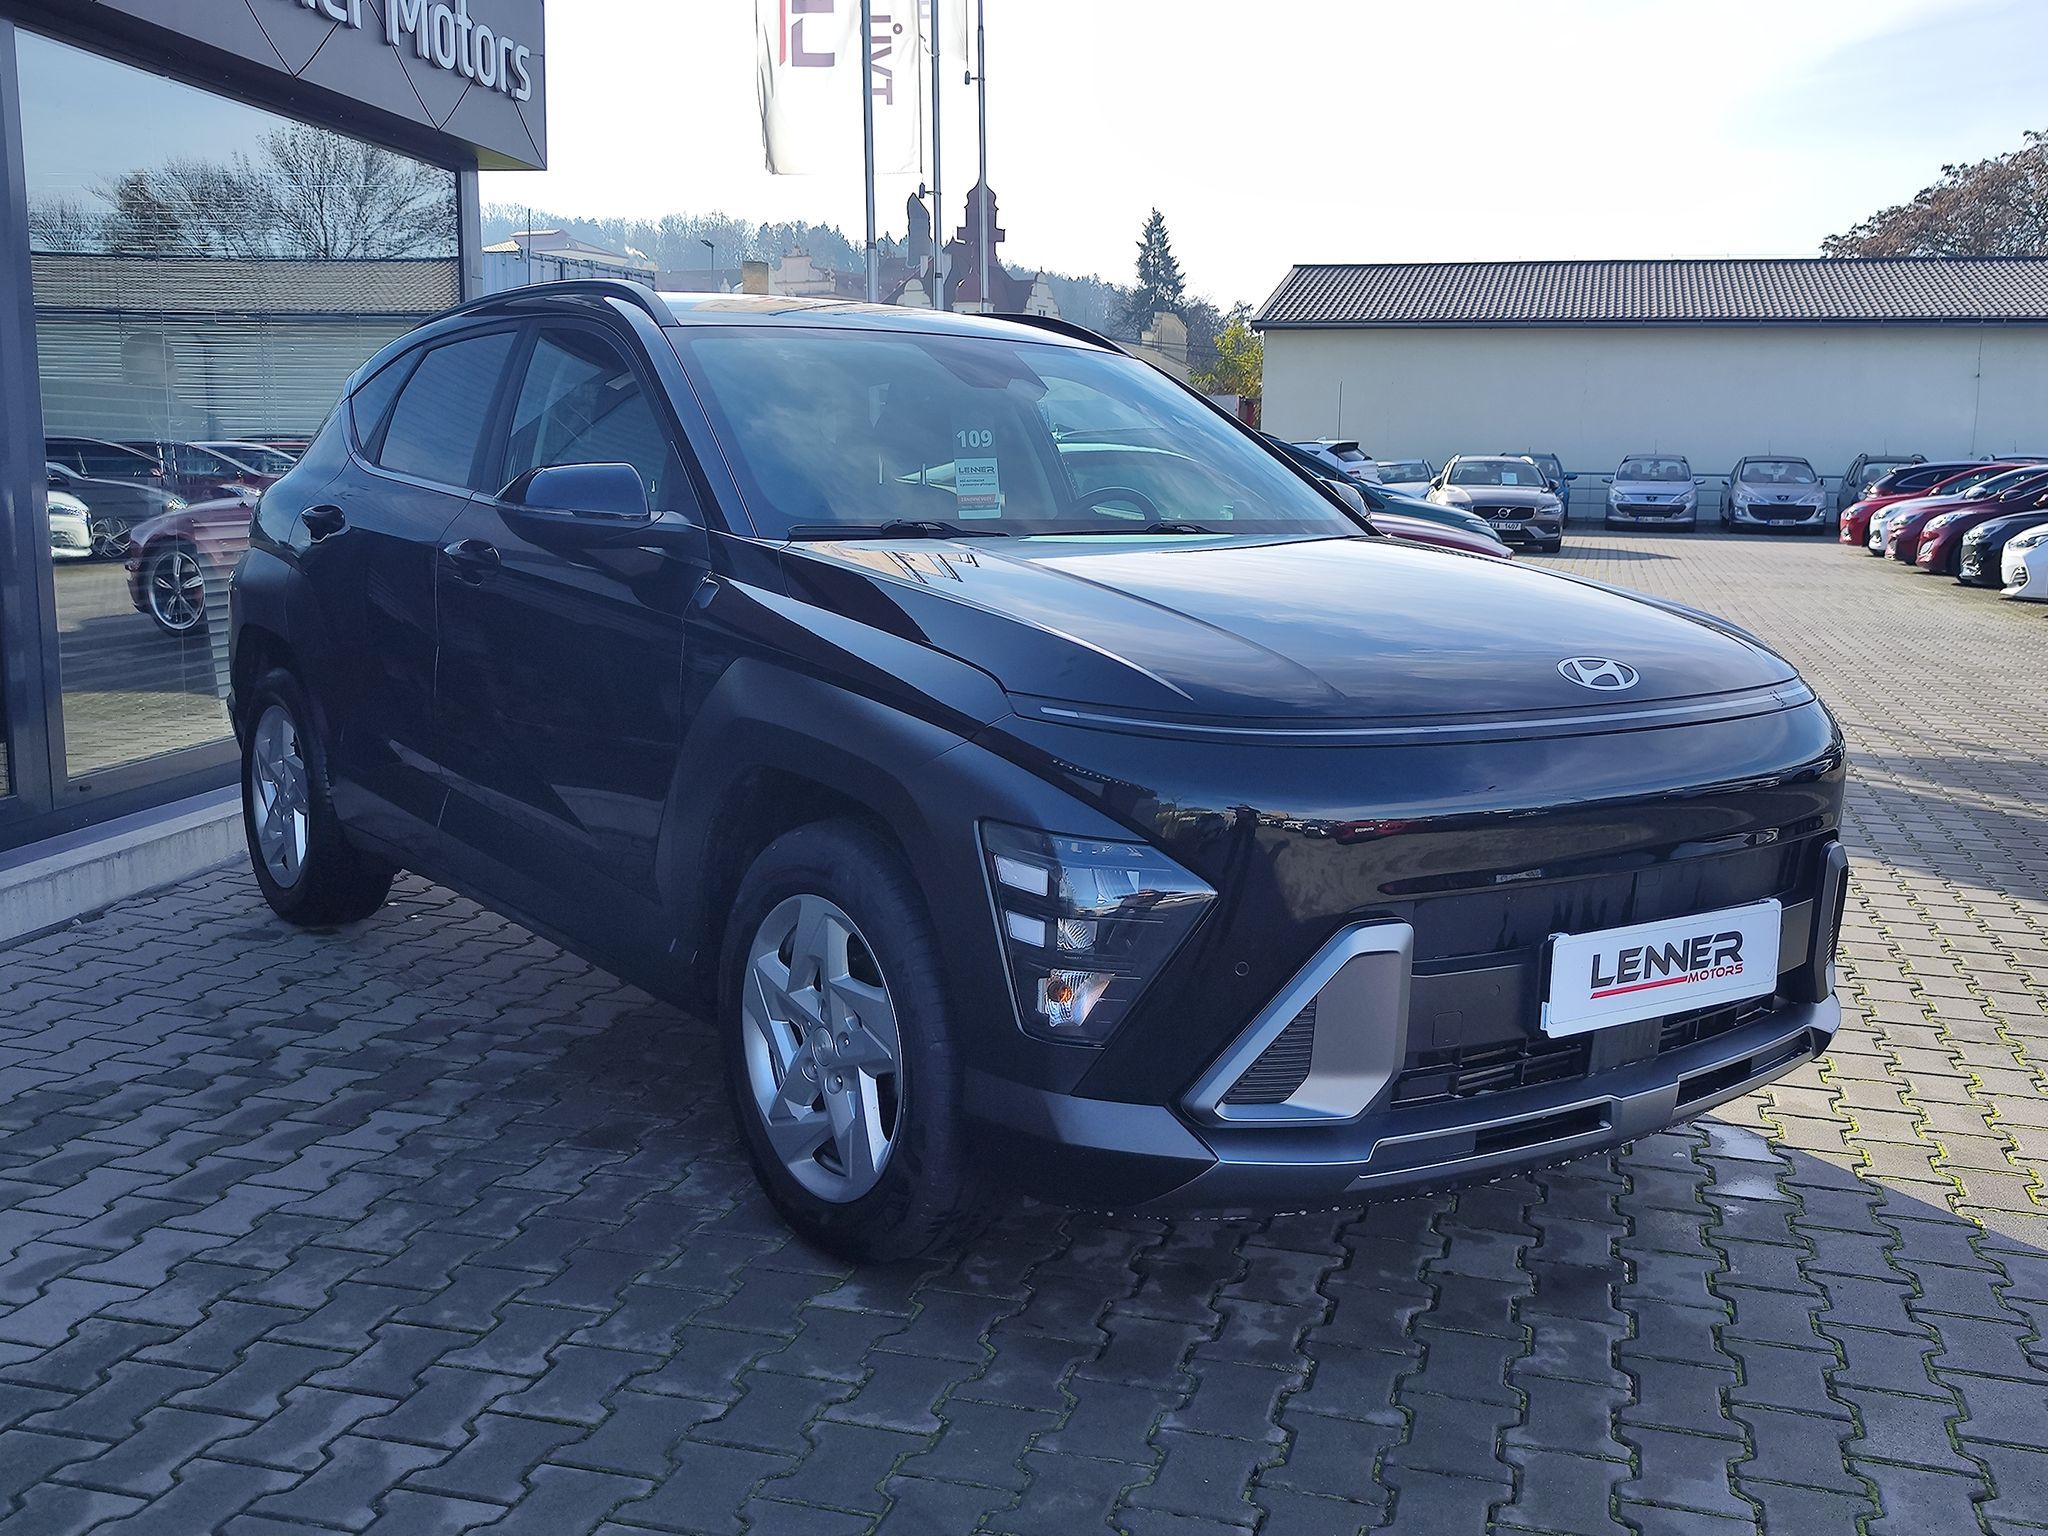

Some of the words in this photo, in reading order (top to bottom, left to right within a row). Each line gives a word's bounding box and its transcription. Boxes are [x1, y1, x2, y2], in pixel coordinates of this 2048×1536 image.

[384, 0, 532, 102] Motors
[956, 429, 993, 448] 109
[958, 466, 996, 474] LENNER
[1590, 930, 1744, 989] LENNER
[1687, 962, 1744, 984] MOTORS
